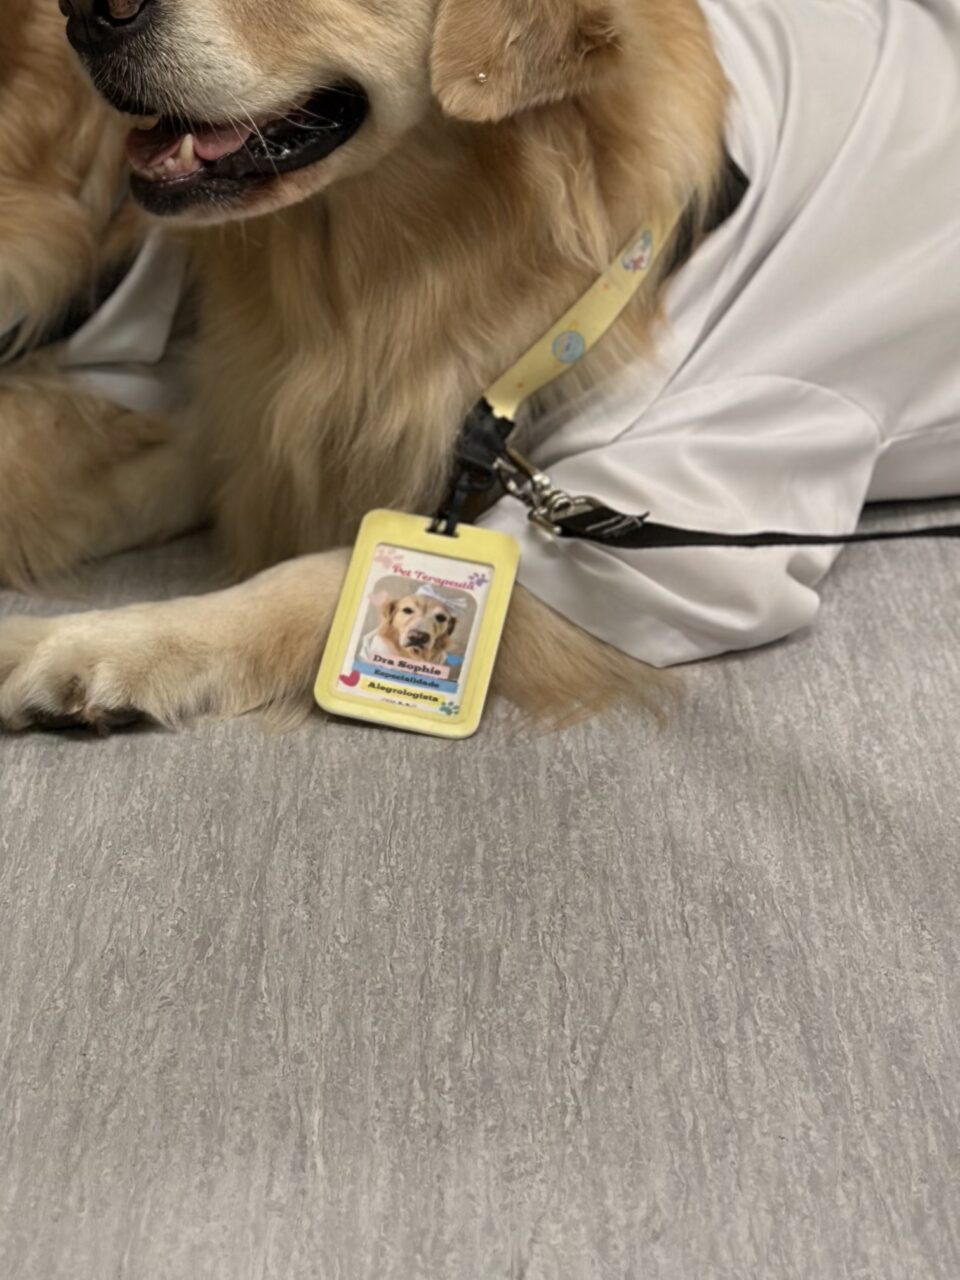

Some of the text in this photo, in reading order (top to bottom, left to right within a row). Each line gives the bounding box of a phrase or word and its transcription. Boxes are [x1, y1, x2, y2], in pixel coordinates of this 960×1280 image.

[392, 563, 474, 590] Pet Terapeuta
[373, 654, 441, 676] Dra Sophie
[374, 668, 439, 688] Especialidade
[368, 681, 439, 702] Alegrologista
